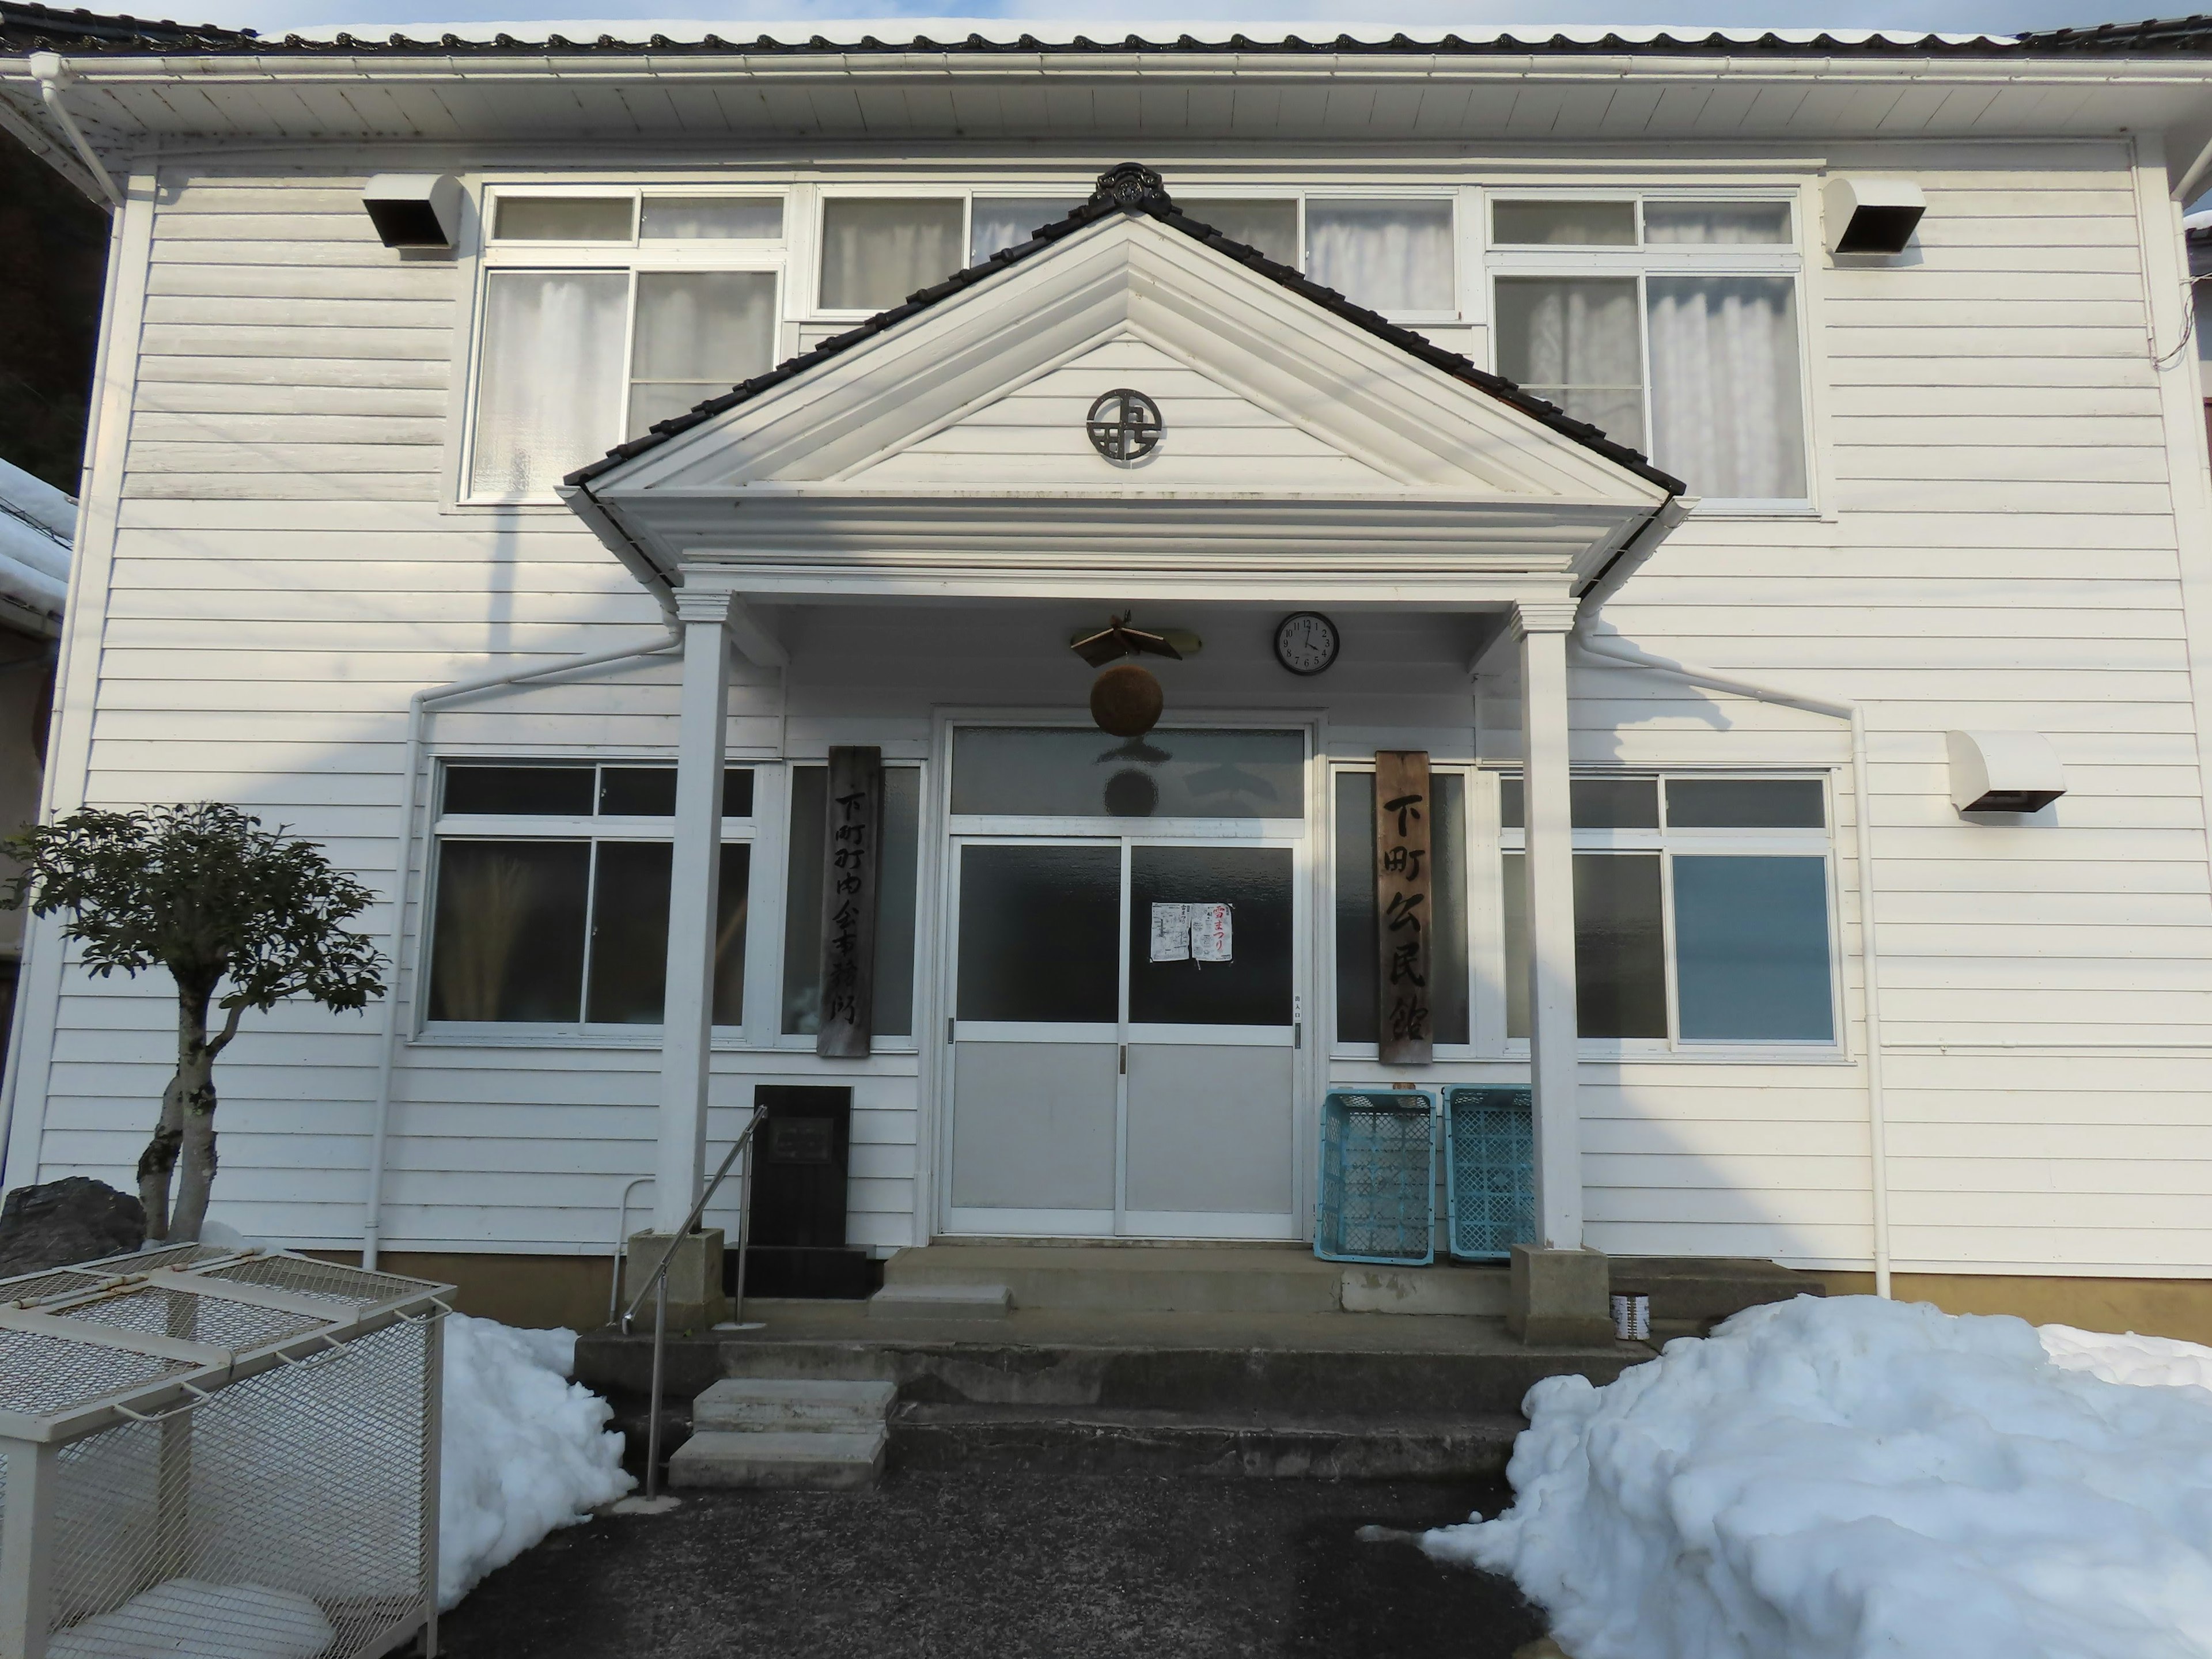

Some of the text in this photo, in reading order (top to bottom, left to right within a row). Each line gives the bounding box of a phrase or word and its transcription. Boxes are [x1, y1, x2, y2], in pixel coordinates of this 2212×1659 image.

[1304, 620, 1311, 628] 12
[1286, 630, 1293, 638] 10
[1322, 630, 1327, 638] 2
[1283, 639, 1288, 647] 9
[1286, 649, 1291, 657] 8
[1384, 794, 1429, 1041] 下町公民館
[1213, 906, 1225, 950] 雪まつり
